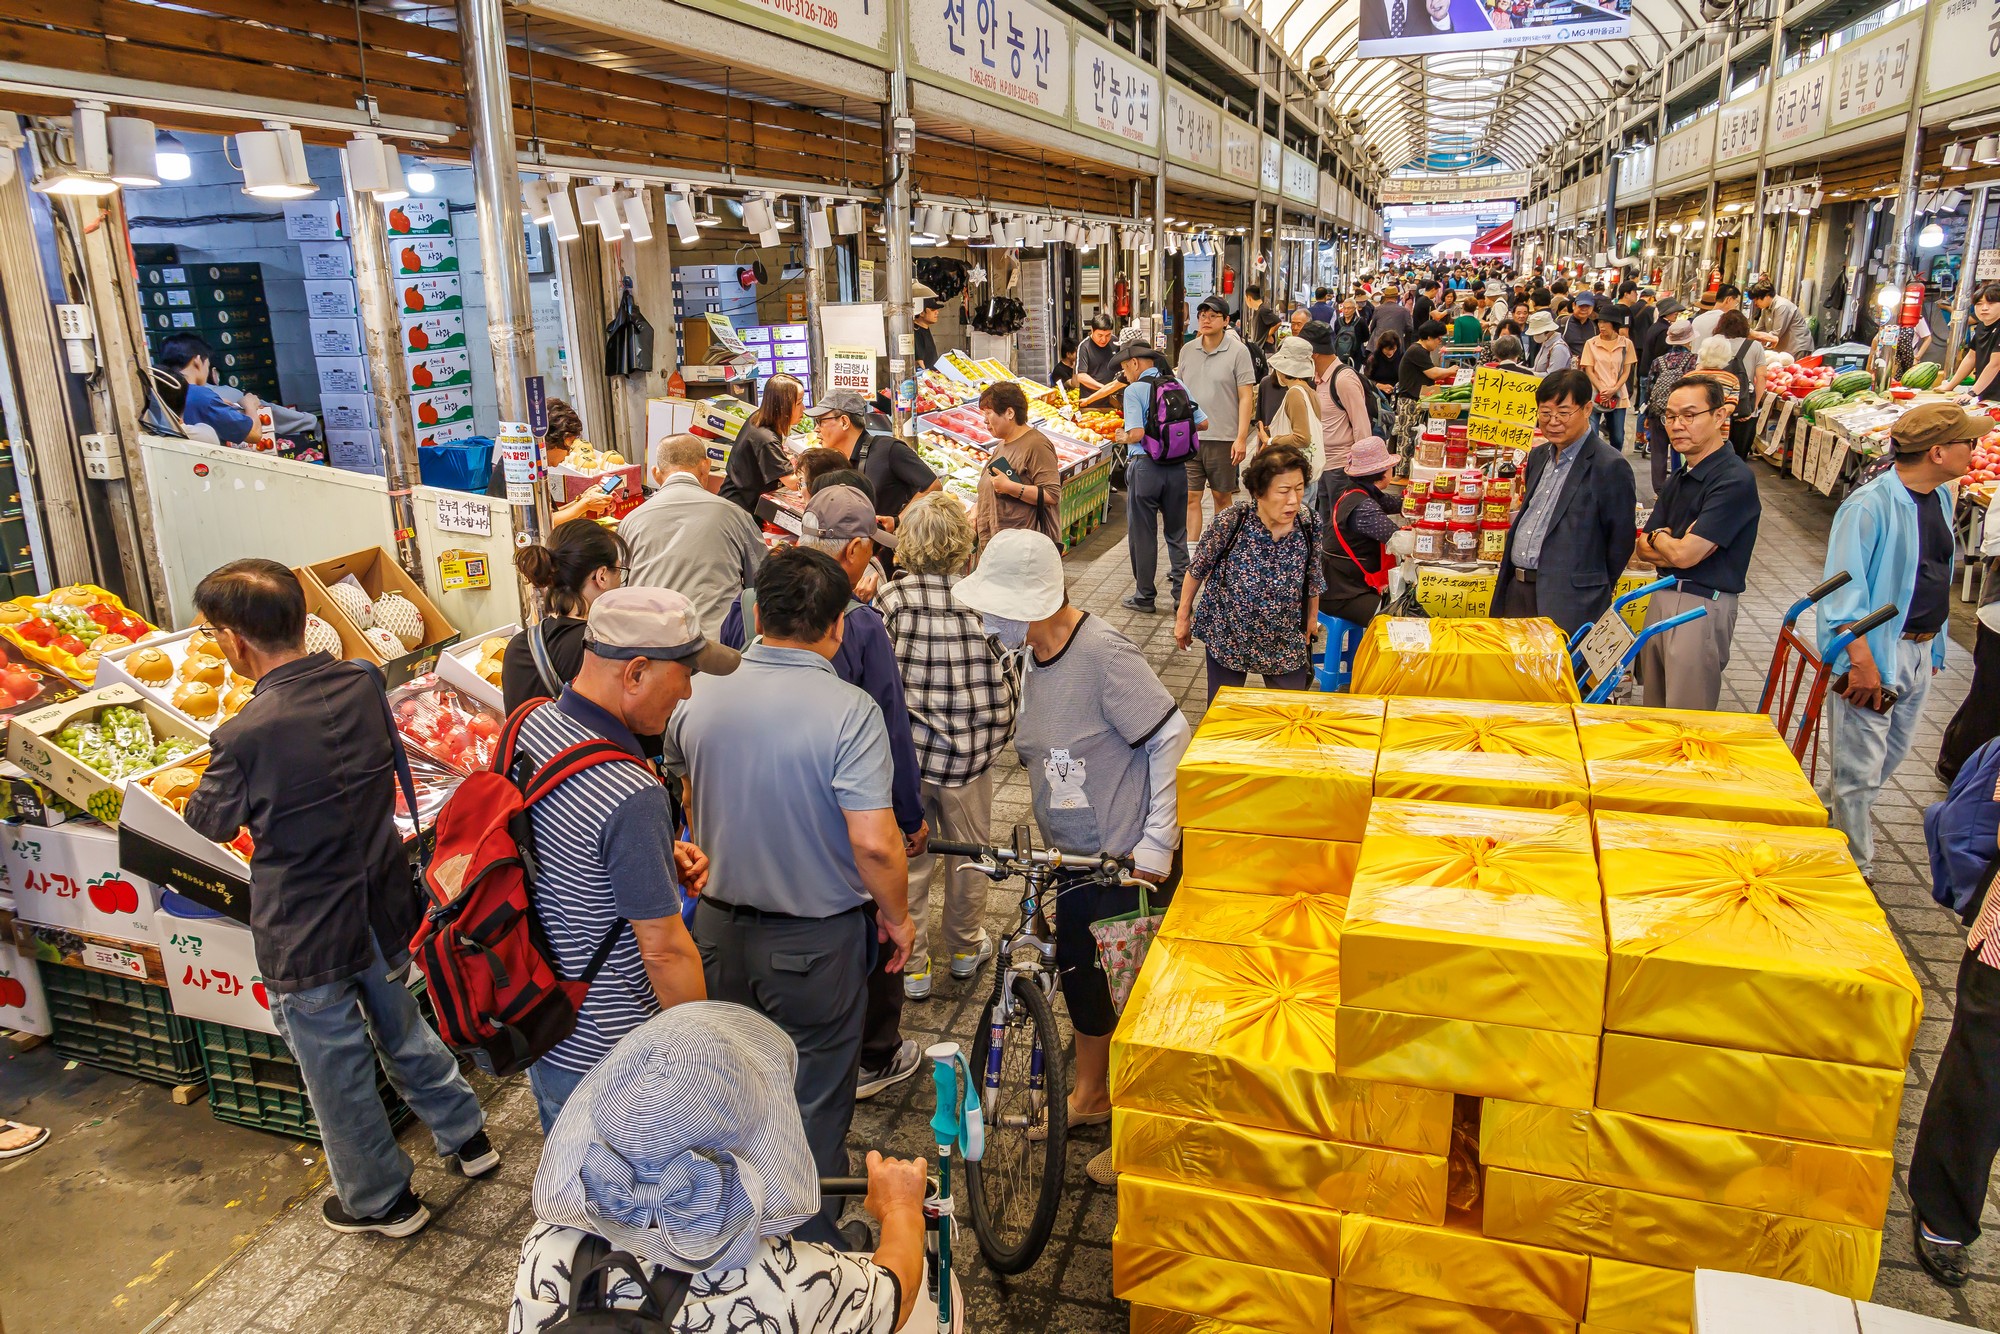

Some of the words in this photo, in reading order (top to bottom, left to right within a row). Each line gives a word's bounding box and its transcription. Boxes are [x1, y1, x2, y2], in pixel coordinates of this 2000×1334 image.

[1571, 29, 1585, 37] MG
[1586, 26, 1622, 37] 새마을금고
[1093, 57, 1150, 131] 한농상회
[834, 362, 869, 375] 환급행사
[834, 375, 869, 387] 참여점포
[1478, 372, 1504, 394] 낙지
[512, 451, 530, 461] 할인!
[1419, 591, 1464, 609] 조개젓
[1468, 601, 1486, 616] 더덕
[12, 839, 42, 862] 산골
[24, 869, 81, 899] 사과
[170, 933, 203, 957] 산골
[182, 964, 244, 996] 사과
